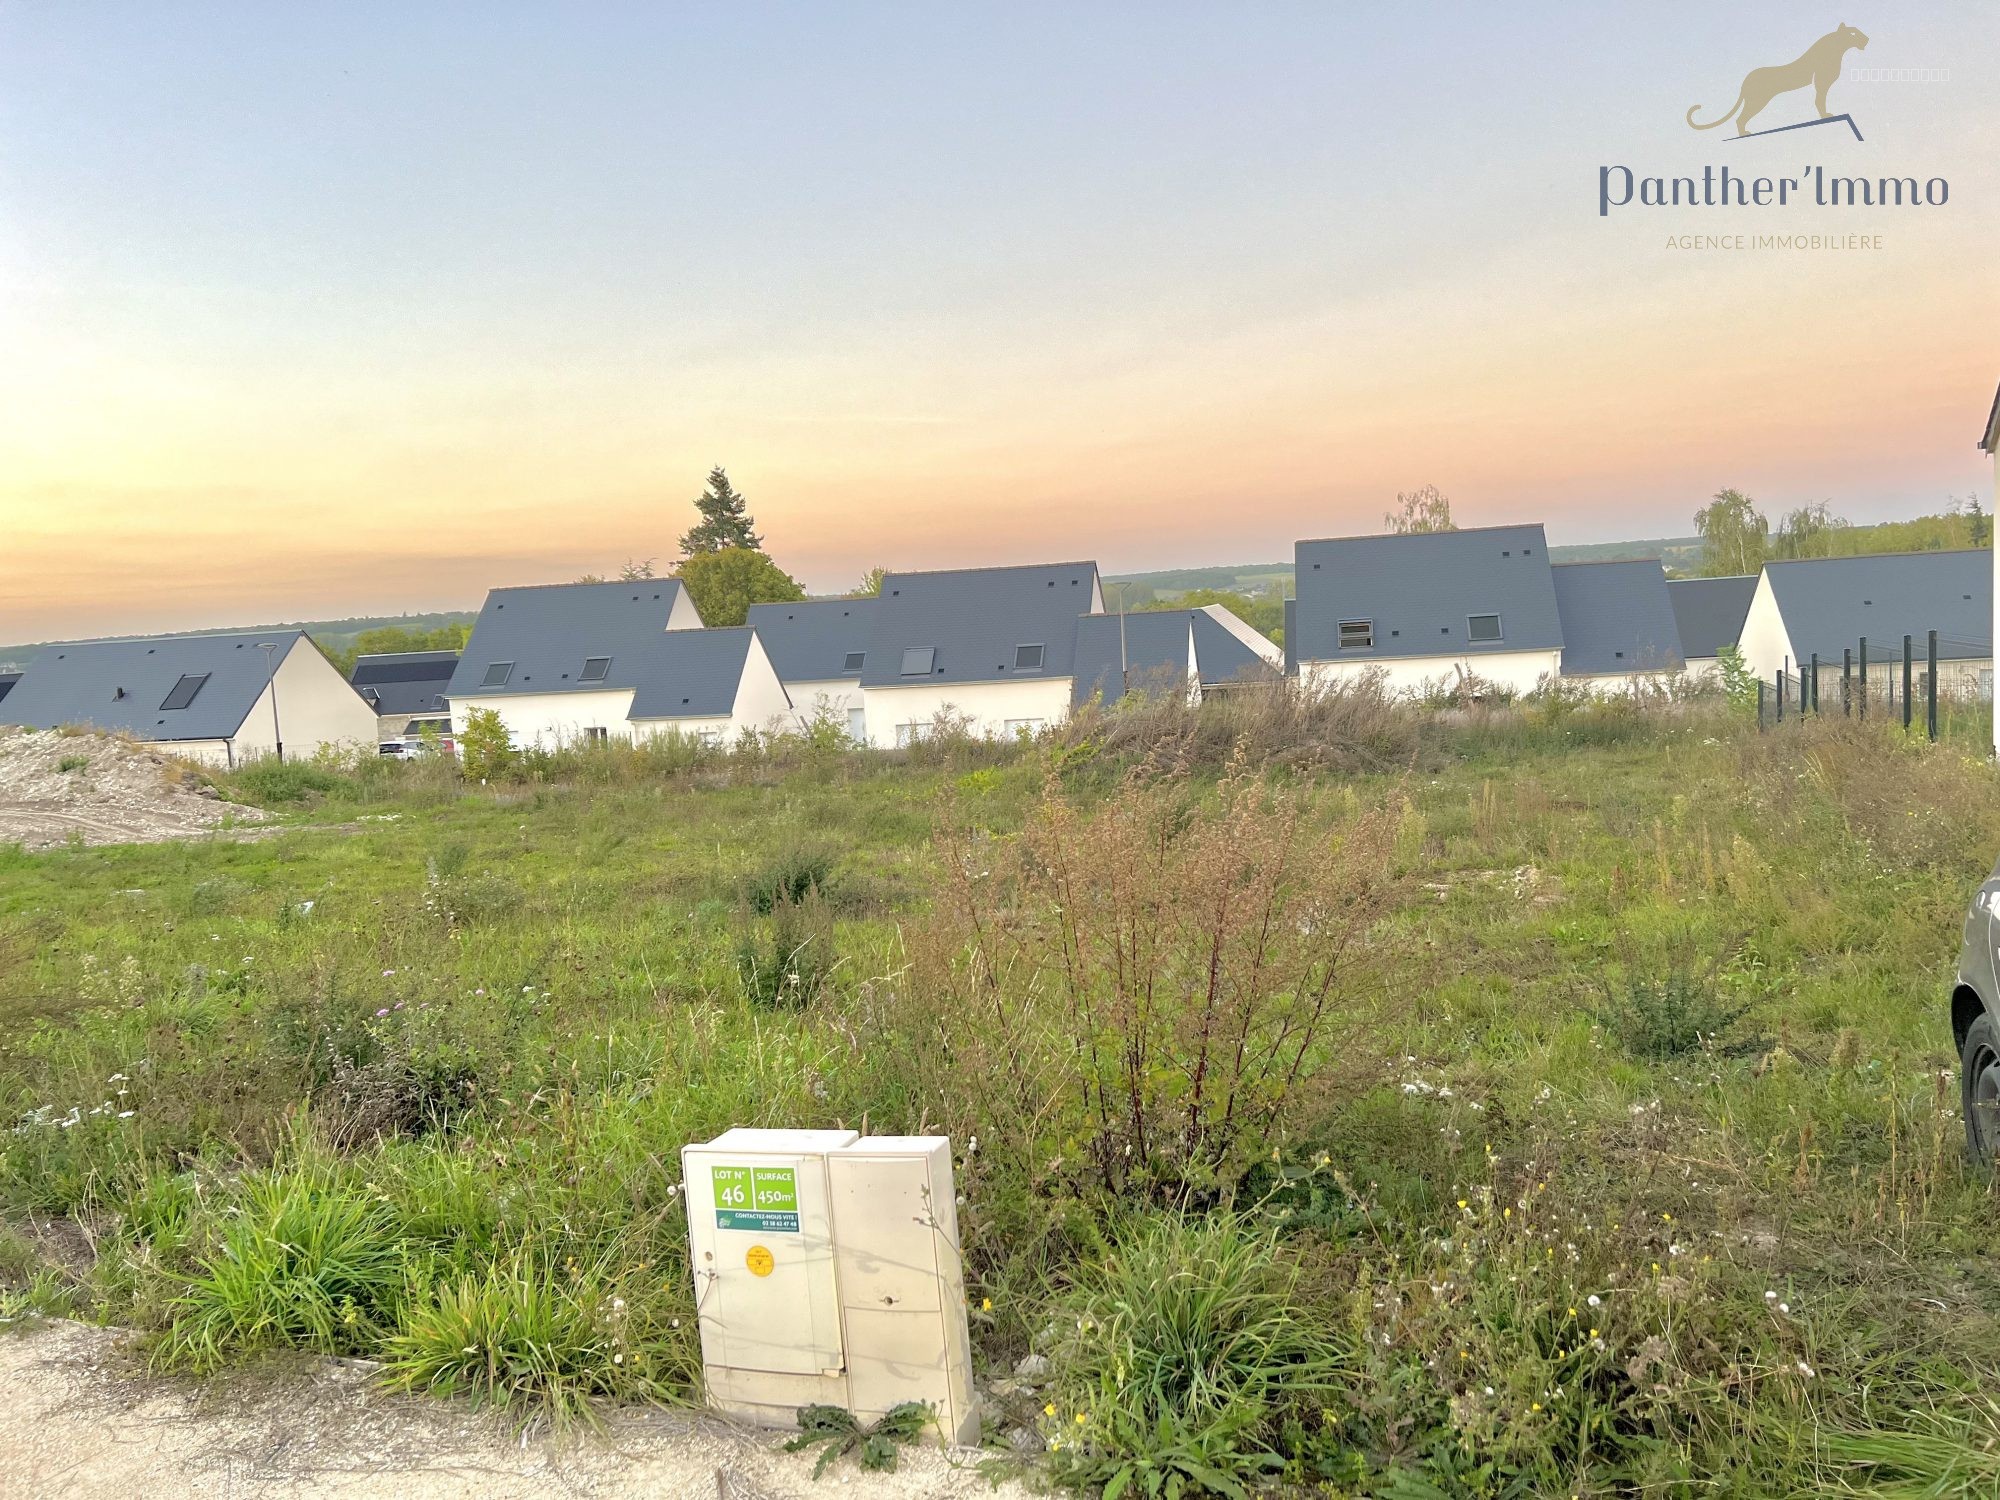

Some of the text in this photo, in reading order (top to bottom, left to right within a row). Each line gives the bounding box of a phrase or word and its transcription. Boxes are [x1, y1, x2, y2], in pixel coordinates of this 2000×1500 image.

[714, 1170, 745, 1180] LOT N°
[756, 1172, 792, 1181] SURFACE
[721, 1185, 745, 1206] 46
[757, 1190, 794, 1205] 450m²
[735, 1212, 782, 1220] CONTACTEZ-NOUS
